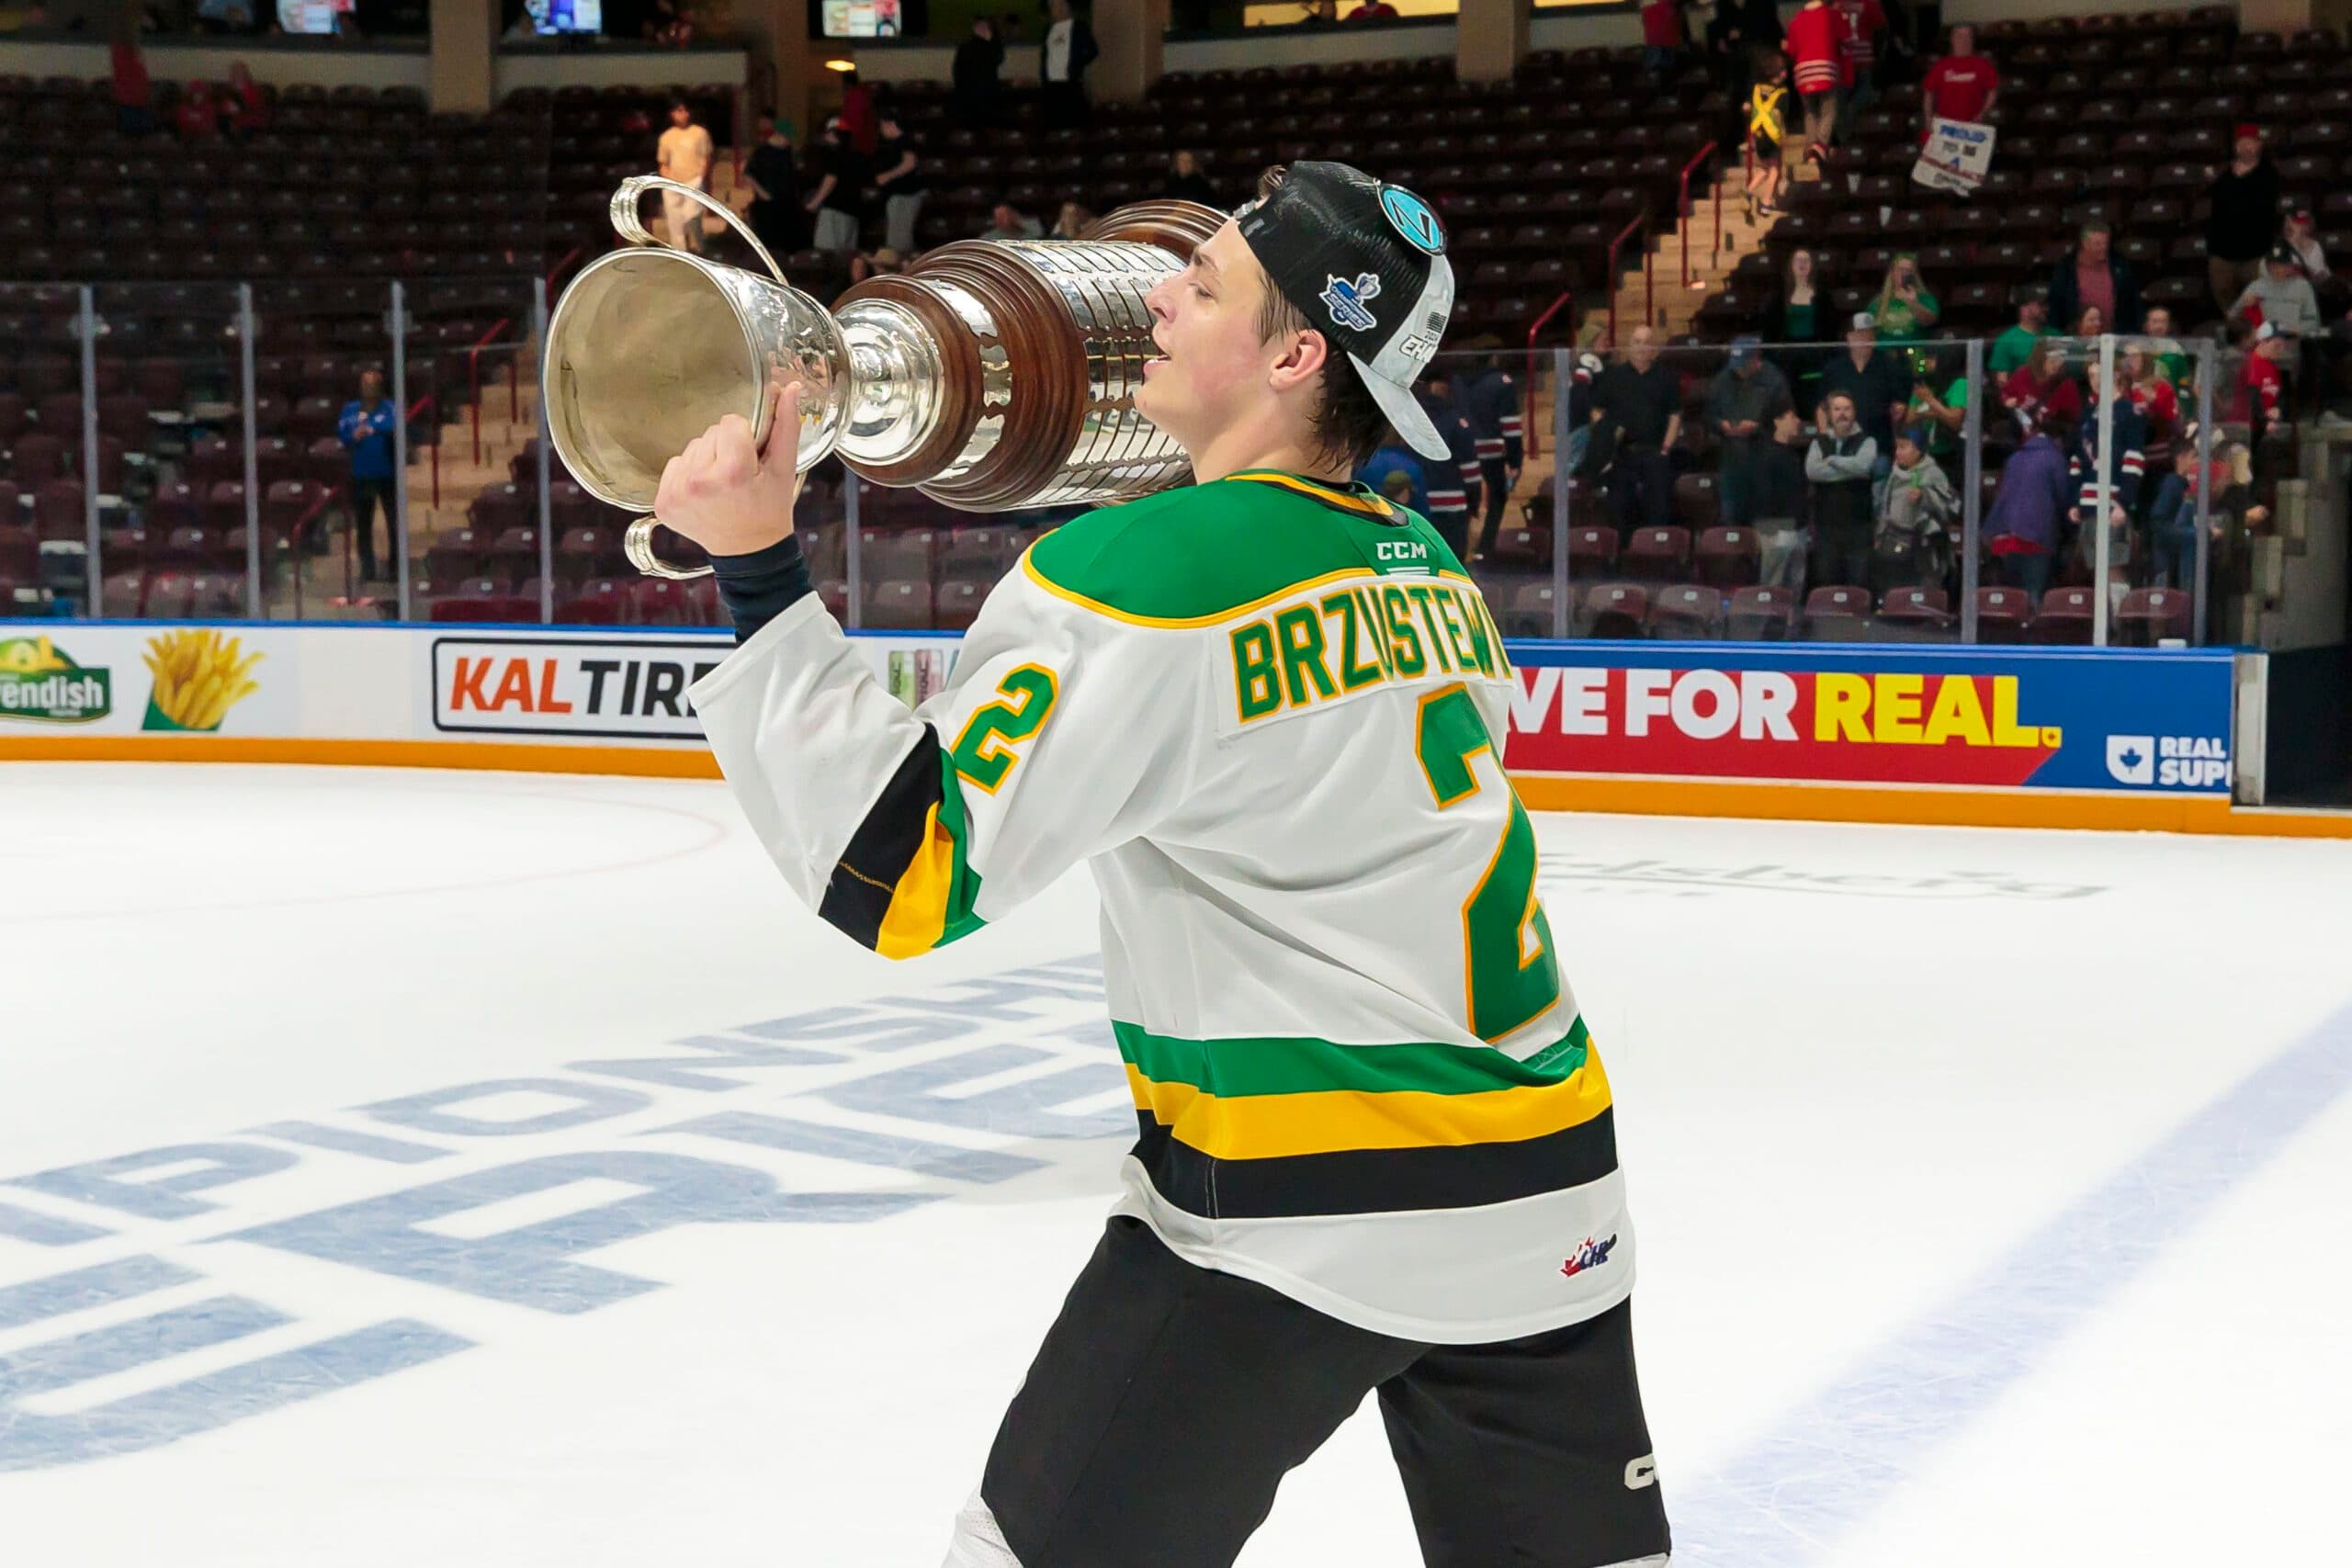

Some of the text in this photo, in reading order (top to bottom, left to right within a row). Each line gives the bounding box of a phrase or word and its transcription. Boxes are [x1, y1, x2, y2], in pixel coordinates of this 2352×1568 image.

[1329, 293, 1367, 328] SERIES
[1376, 540, 1427, 560] CCM
[0, 674, 104, 709] endish
[450, 657, 572, 715] KAL
[1624, 669, 1800, 741] FOR
[949, 661, 1059, 797] 2
[2160, 736, 2227, 760] REAL
[1415, 681, 1560, 1045] 2
